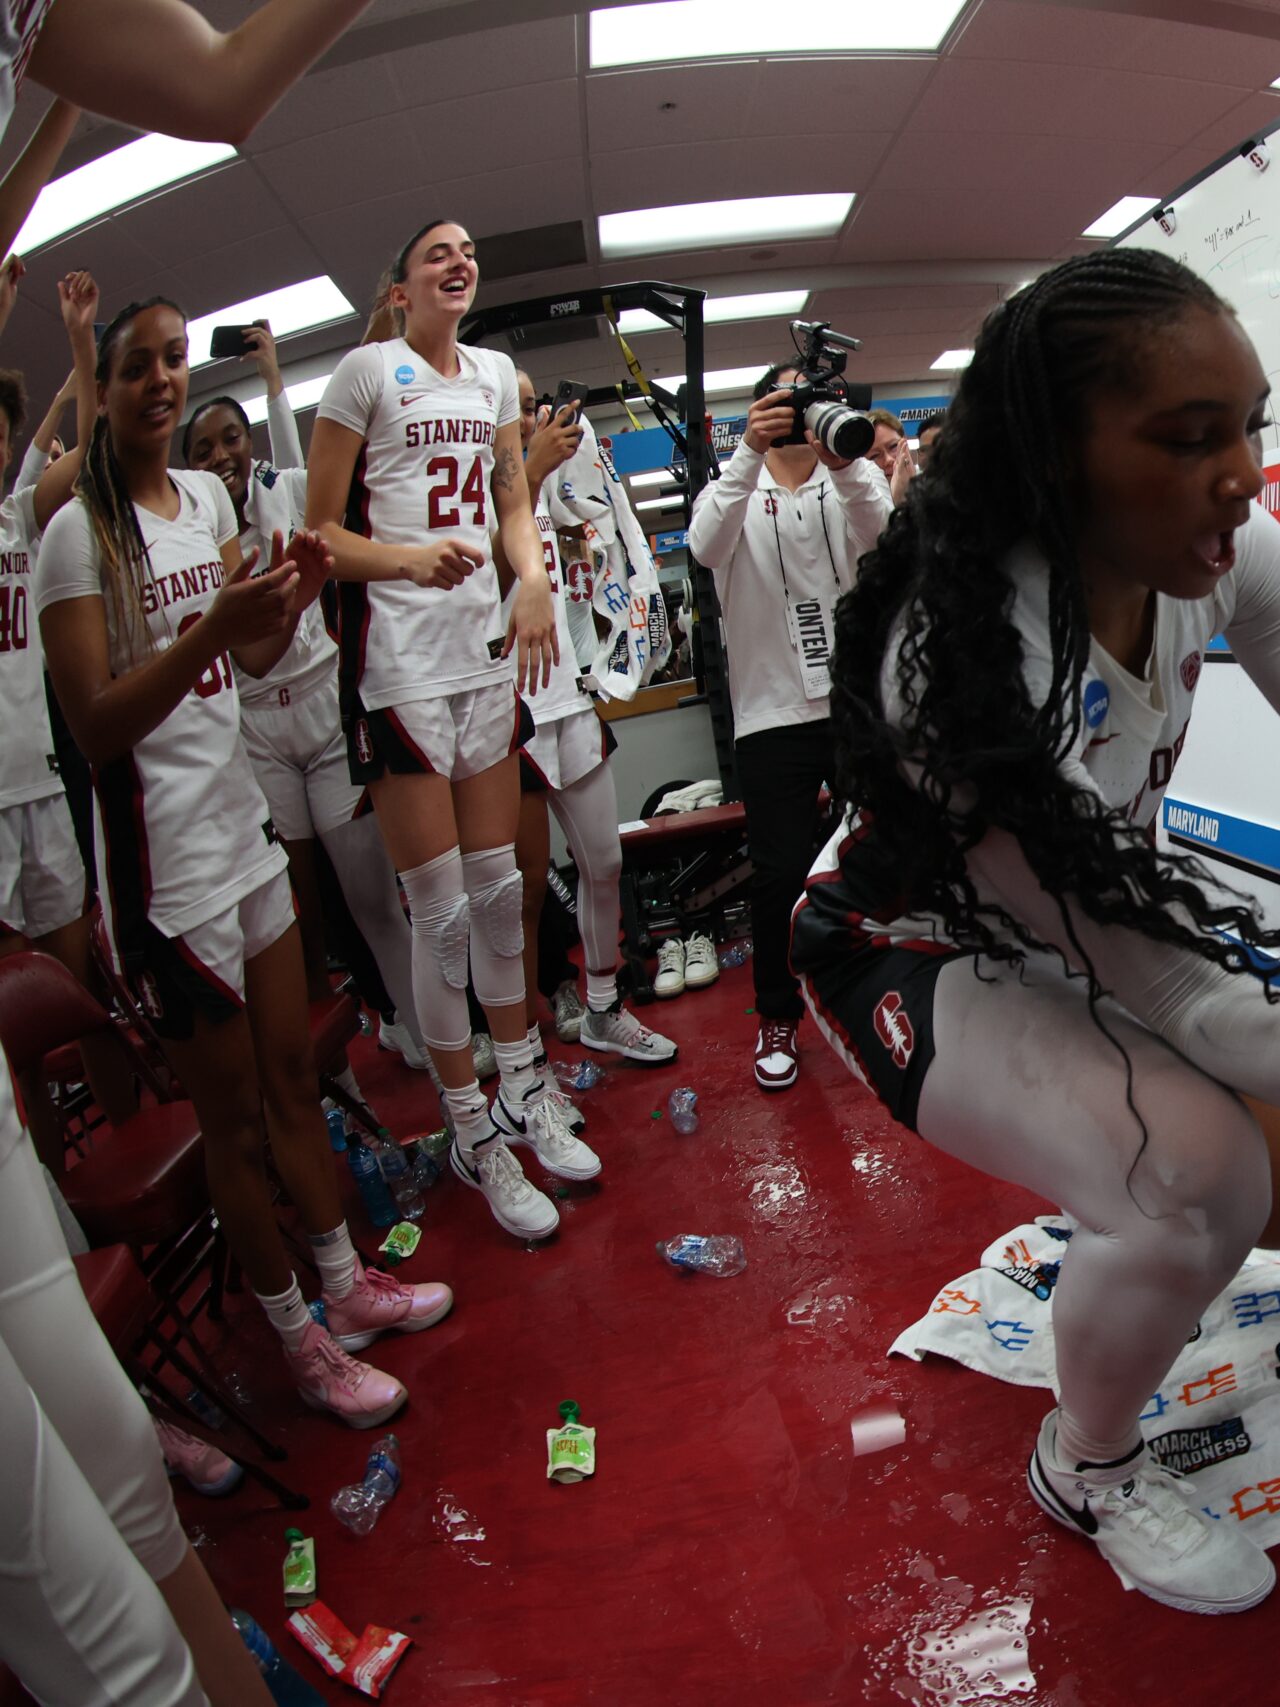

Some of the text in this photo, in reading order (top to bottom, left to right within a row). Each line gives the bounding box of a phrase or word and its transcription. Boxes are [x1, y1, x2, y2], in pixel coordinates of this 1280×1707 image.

[427, 455, 485, 530] 24
[1167, 805, 1219, 843] MARYLAND
[1152, 1430, 1212, 1456] MARCH
[1163, 1432, 1249, 1474] MADNESS
